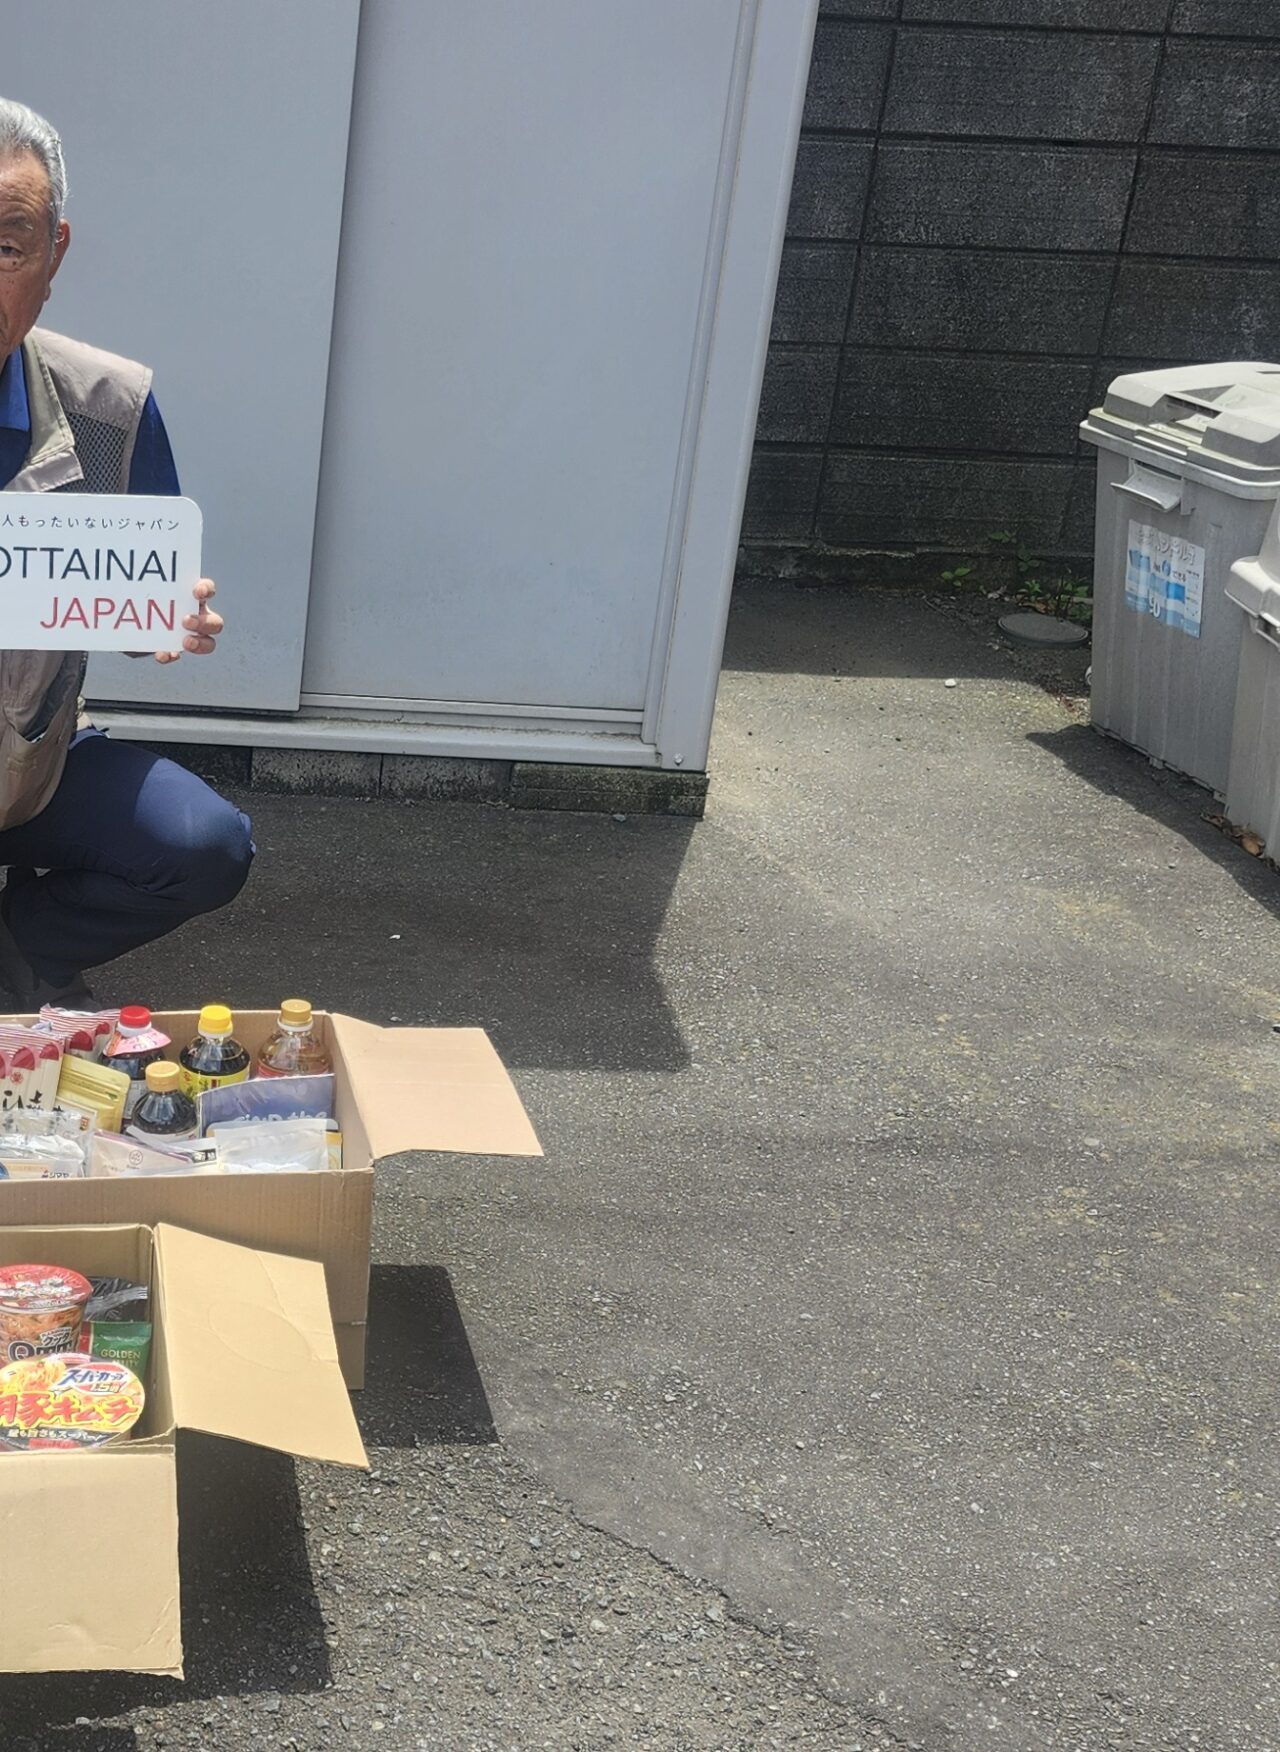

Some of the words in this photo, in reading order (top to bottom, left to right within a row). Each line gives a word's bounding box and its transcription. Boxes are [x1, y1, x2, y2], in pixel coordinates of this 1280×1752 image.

[40, 596, 176, 631] JAPAN
[101, 1349, 141, 1360] GOLDEN
[58, 1369, 128, 1386] スーパーカップ
